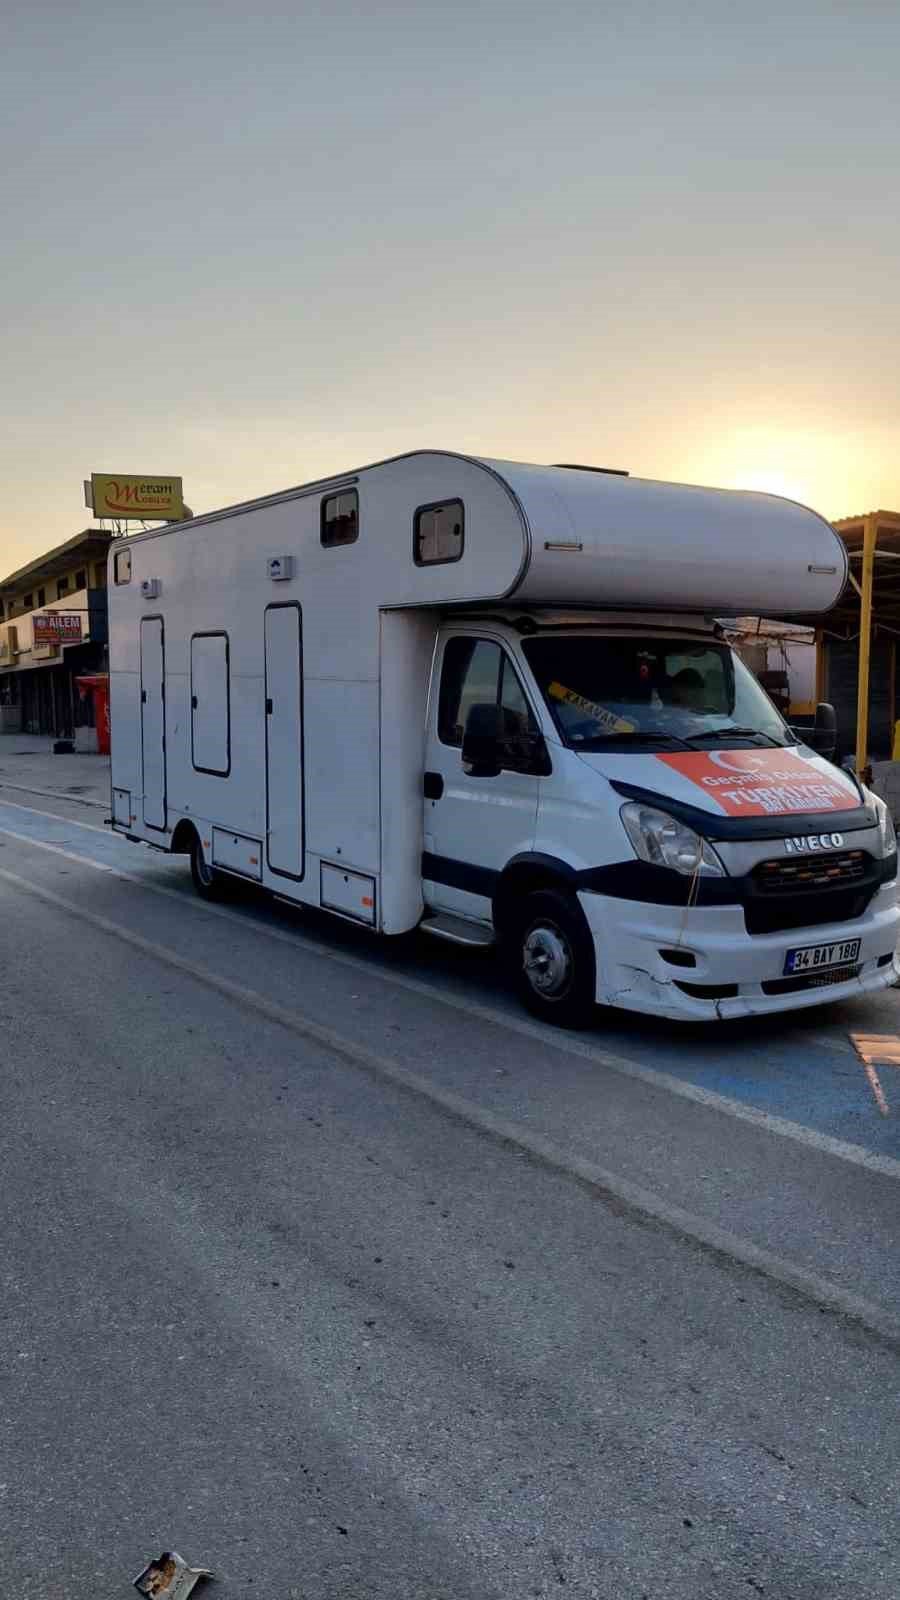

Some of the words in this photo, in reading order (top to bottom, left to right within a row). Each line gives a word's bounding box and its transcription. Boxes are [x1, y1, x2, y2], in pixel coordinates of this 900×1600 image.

[784, 832, 844, 853] IVECO
[795, 951, 810, 969] 34
[813, 946, 835, 965] BAY
[838, 942, 858, 960] 188
